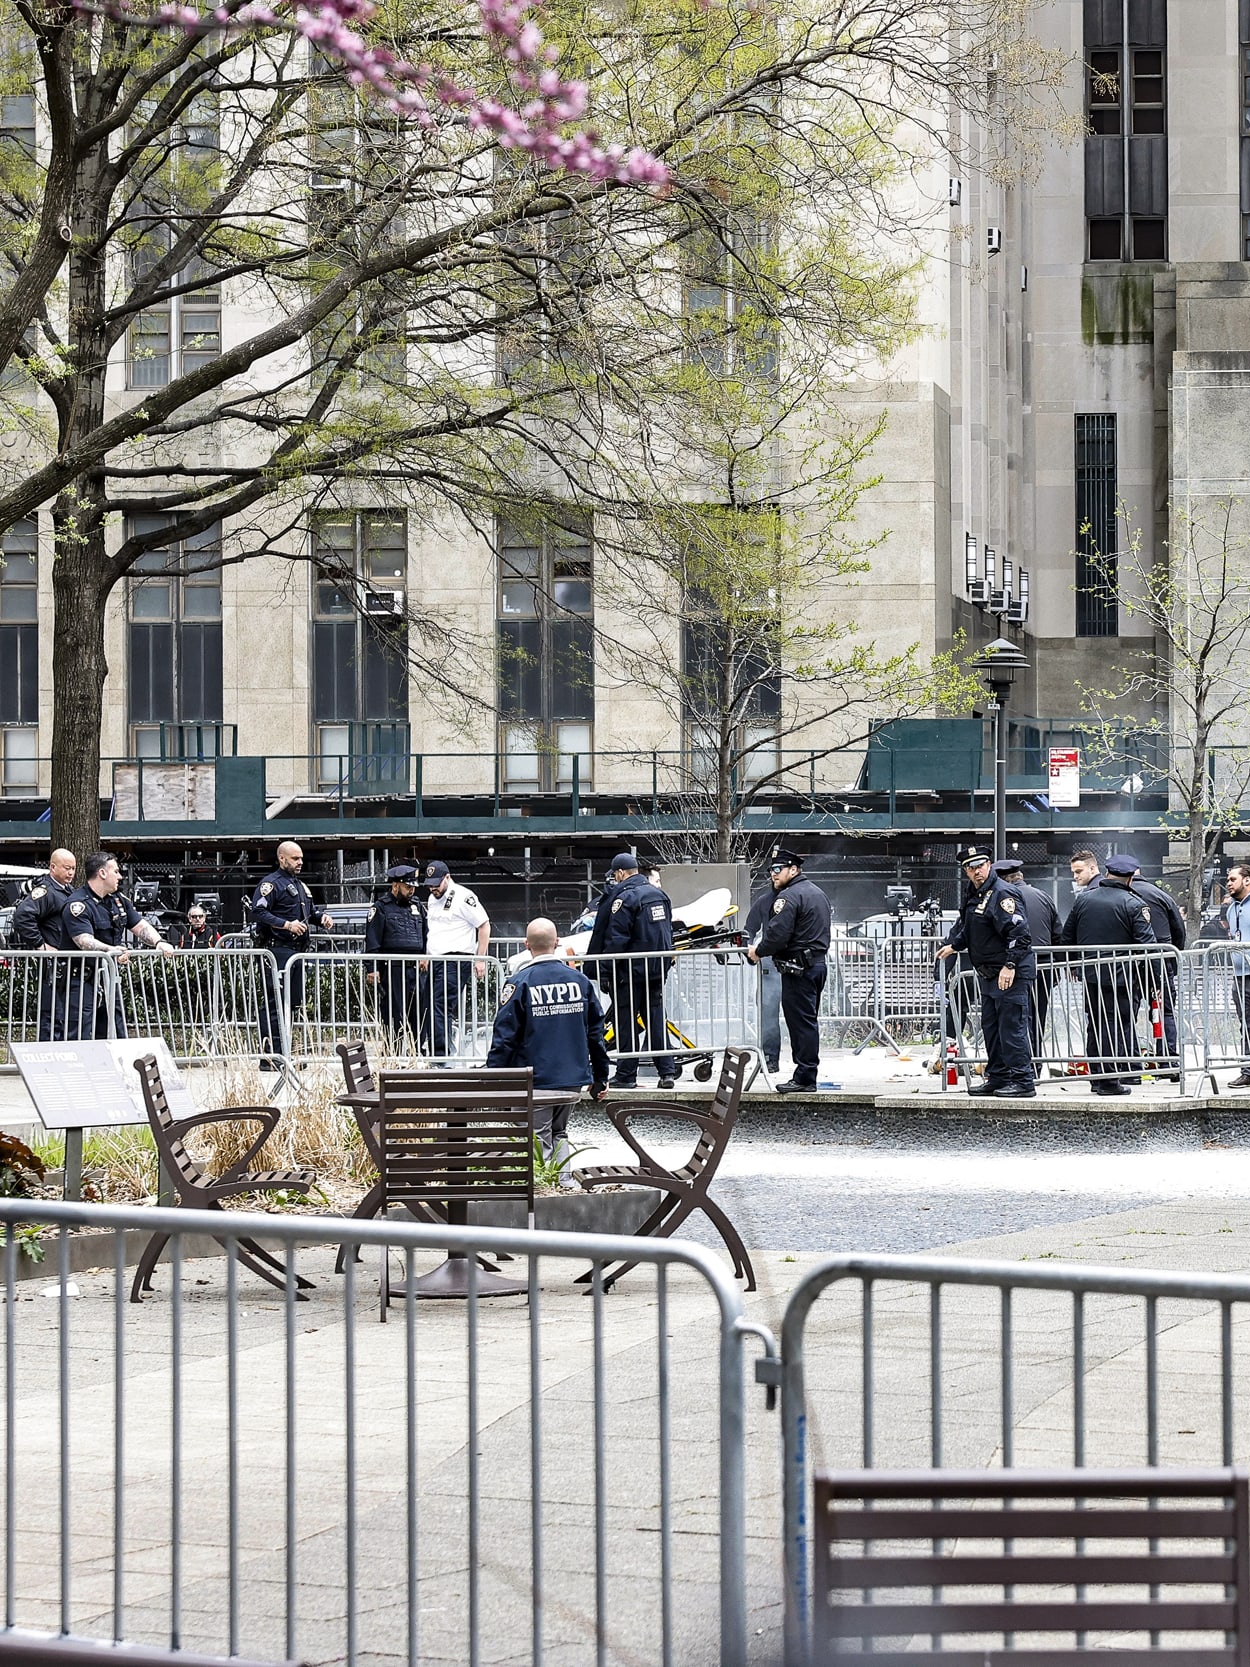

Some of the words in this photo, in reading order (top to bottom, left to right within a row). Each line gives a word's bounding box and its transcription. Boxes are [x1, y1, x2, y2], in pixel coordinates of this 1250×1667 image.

[529, 982, 582, 1005] NYPD
[549, 1002, 584, 1011] COMMISSIONER
[550, 1007, 584, 1015] INFORMATION
[22, 1052, 55, 1063] COLLECT
